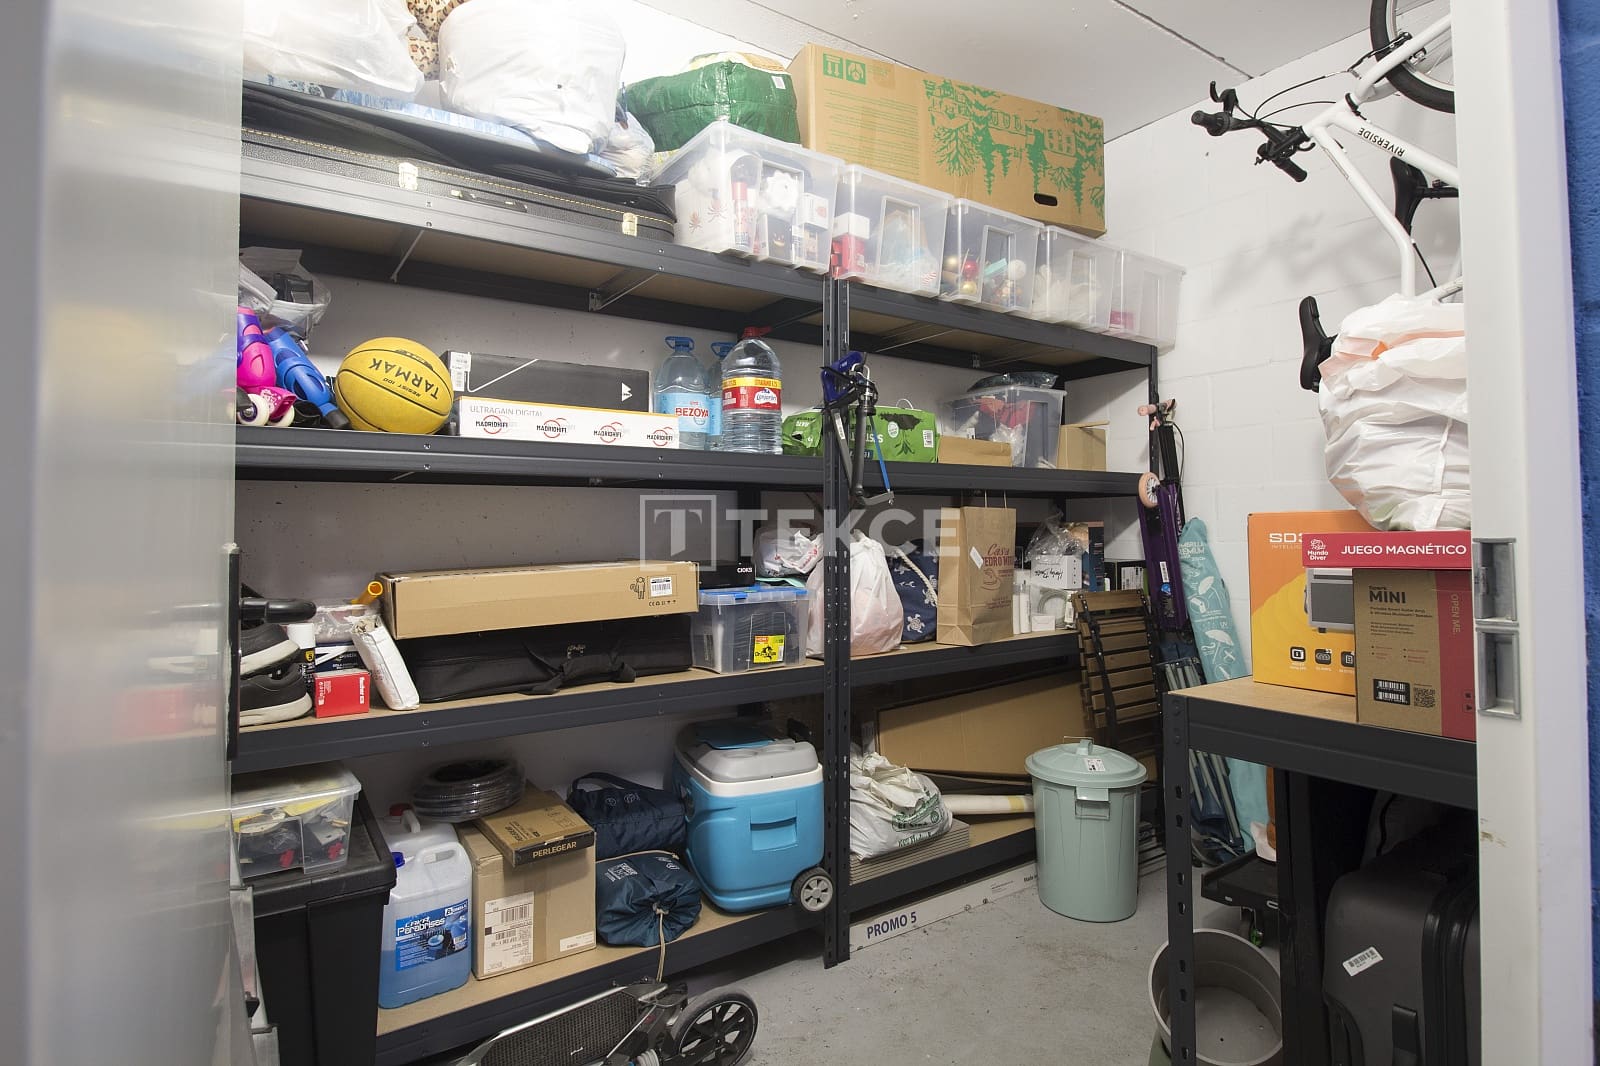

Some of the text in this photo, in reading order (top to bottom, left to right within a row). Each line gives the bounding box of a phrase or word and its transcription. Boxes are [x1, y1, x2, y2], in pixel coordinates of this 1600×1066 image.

[1358, 127, 1405, 157] RIVERSIDE
[369, 357, 439, 400] TARMAK
[398, 384, 422, 398] RESIST
[469, 405, 515, 416] ULTRAGAIN
[675, 407, 709, 418] BEZOYA
[1340, 542, 1467, 556] JUEGO MAGNÉTICO
[1369, 590, 1407, 604] MINI
[1450, 593, 1460, 618] OPEN
[532, 841, 577, 859] PERLEGEAR
[866, 911, 917, 940] PROMO 5
